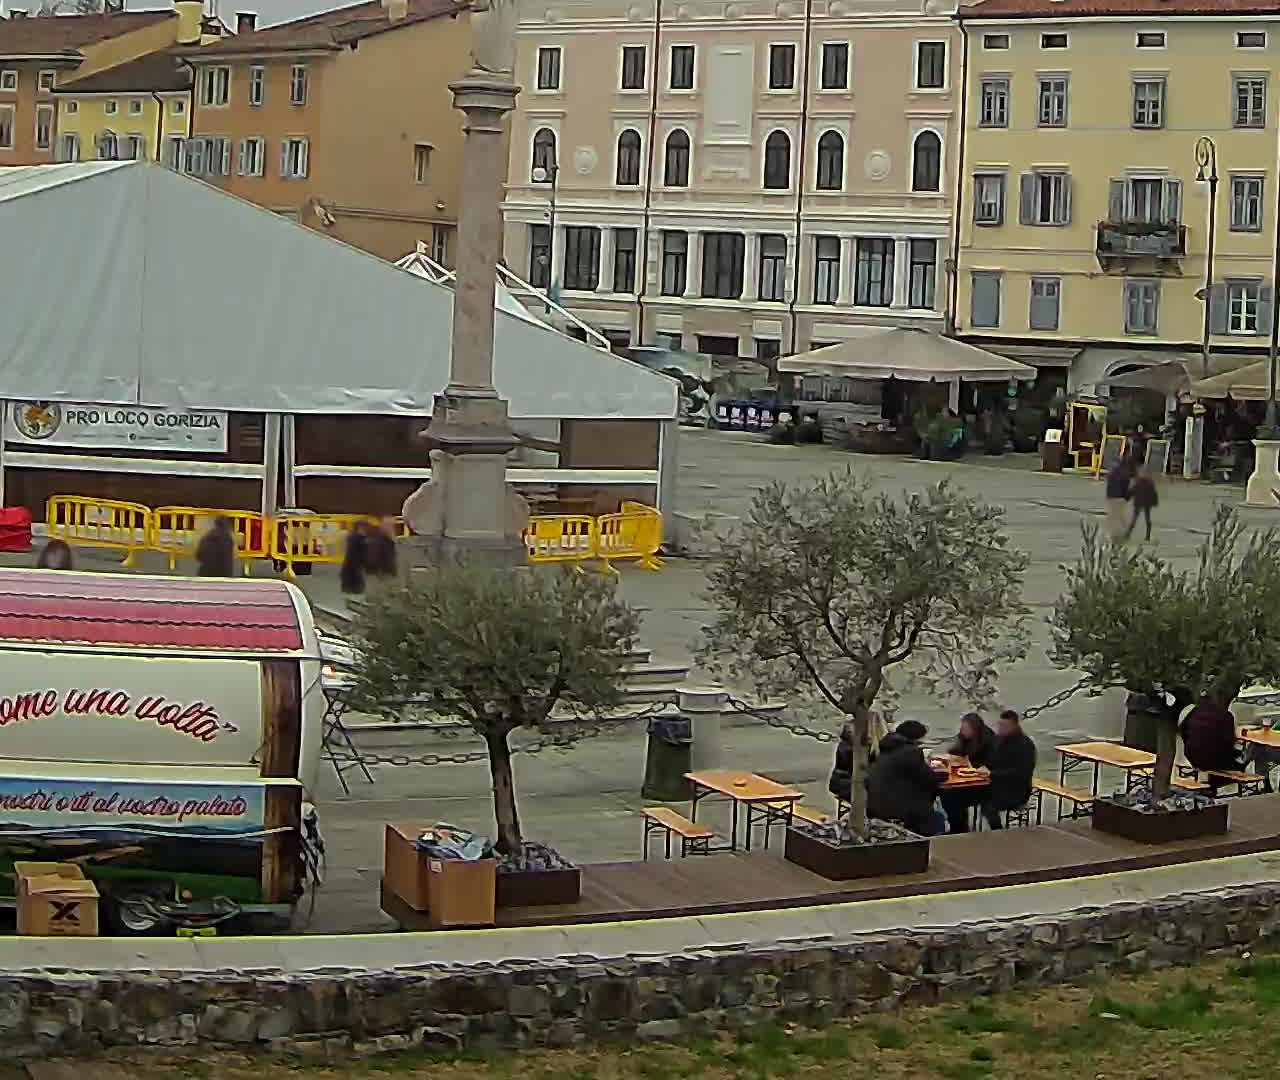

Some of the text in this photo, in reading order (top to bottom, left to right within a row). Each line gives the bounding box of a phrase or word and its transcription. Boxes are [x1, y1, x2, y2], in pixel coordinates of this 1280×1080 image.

[66, 410, 221, 429] PRO LOCO GORIZIA
[63, 688, 130, 716] una
[92, 791, 120, 813] al
[117, 795, 180, 816] vostro
[177, 794, 248, 823] palato
